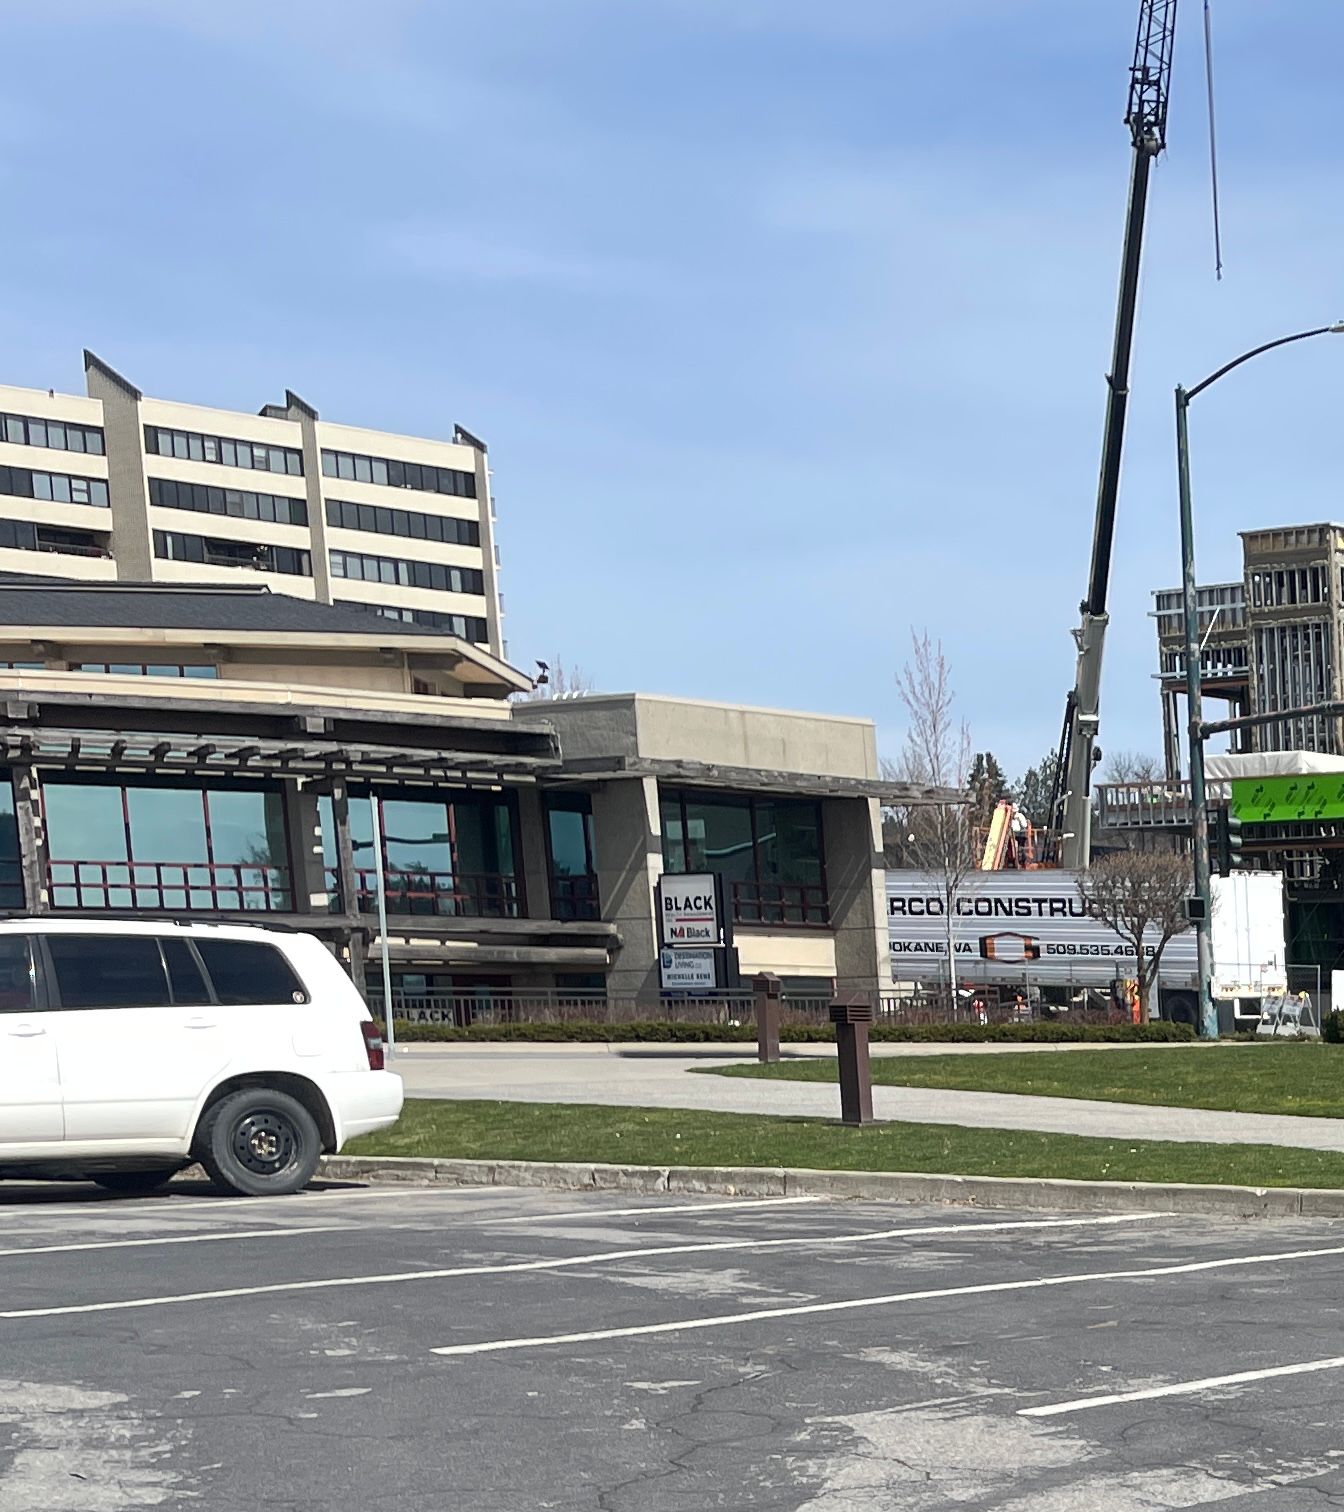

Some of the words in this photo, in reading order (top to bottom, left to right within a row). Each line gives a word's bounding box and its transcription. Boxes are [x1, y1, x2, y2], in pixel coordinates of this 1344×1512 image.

[664, 896, 713, 911] BLACK
[888, 897, 944, 916] RCO
[687, 928, 710, 938] Black
[1047, 943, 1156, 957] 509.535.468
